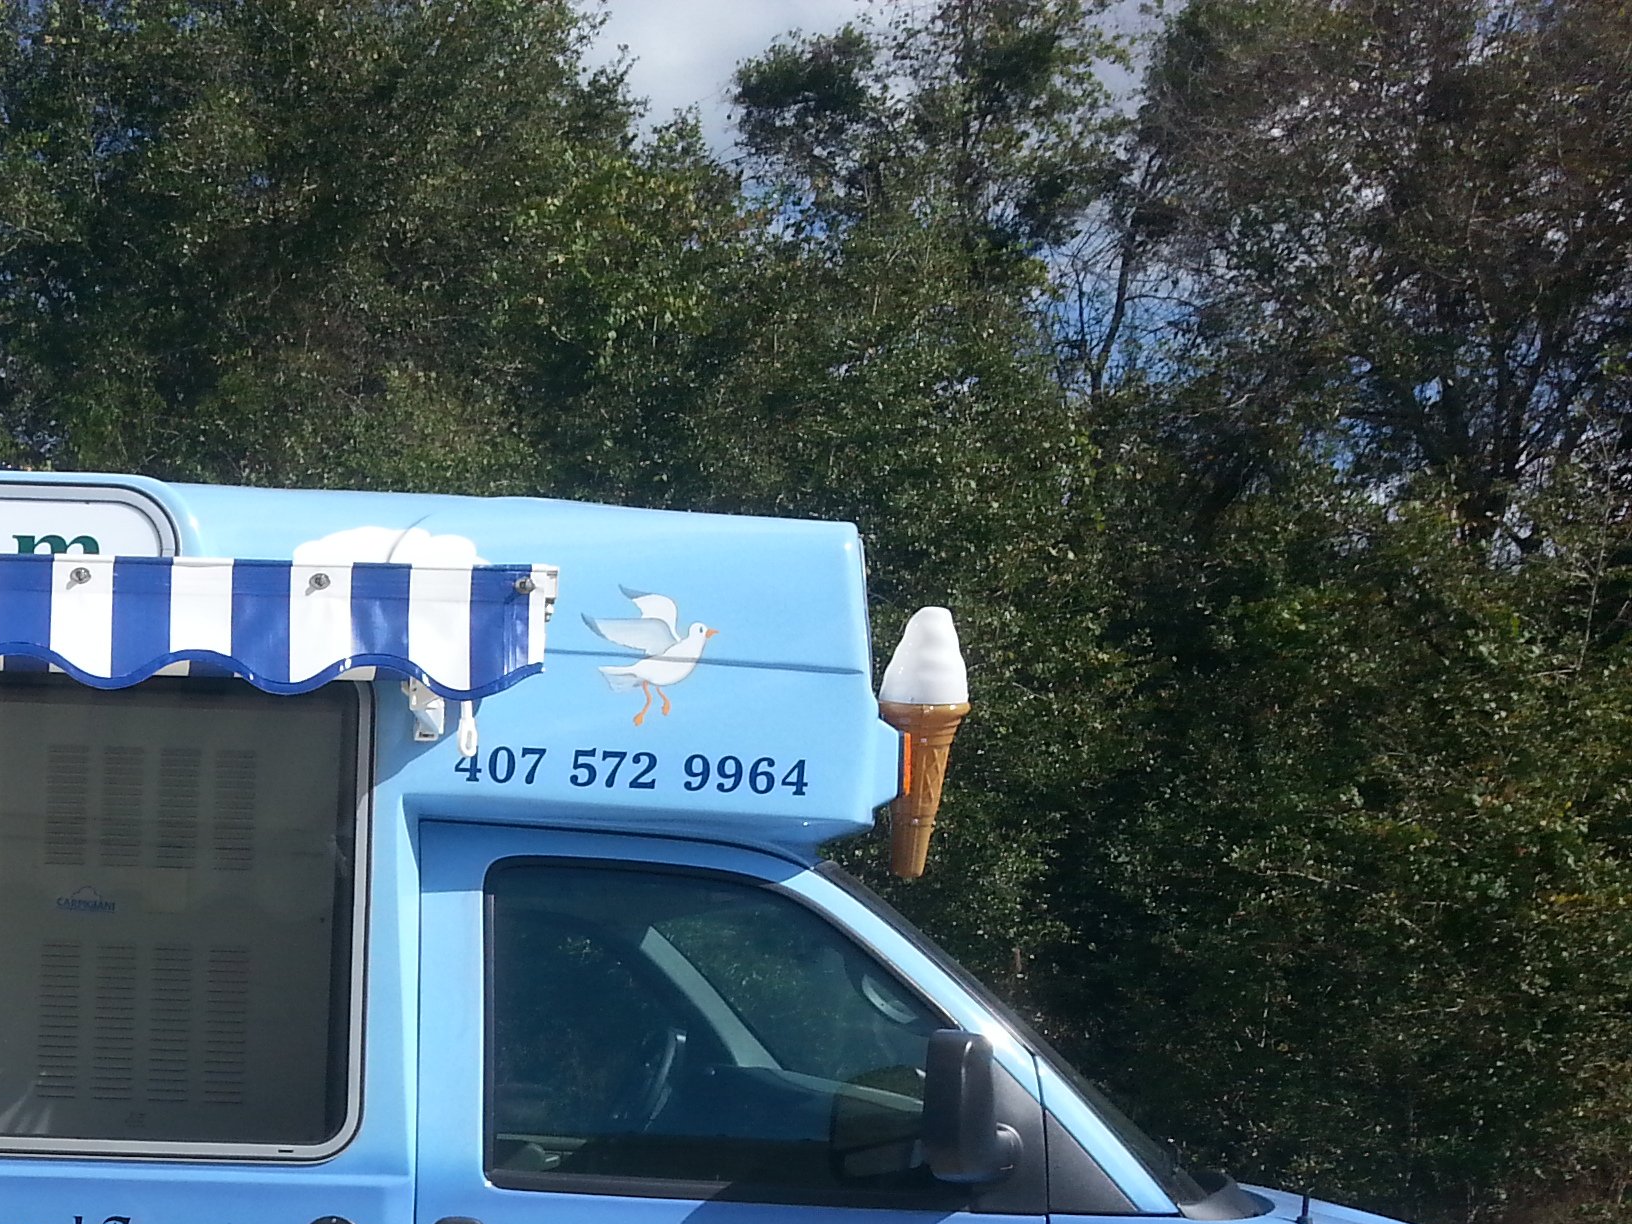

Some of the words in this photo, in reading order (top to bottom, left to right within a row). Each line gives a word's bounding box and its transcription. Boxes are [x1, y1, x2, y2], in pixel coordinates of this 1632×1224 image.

[454, 744, 547, 785] 407
[570, 748, 658, 789] 572
[684, 754, 808, 796] 9964
